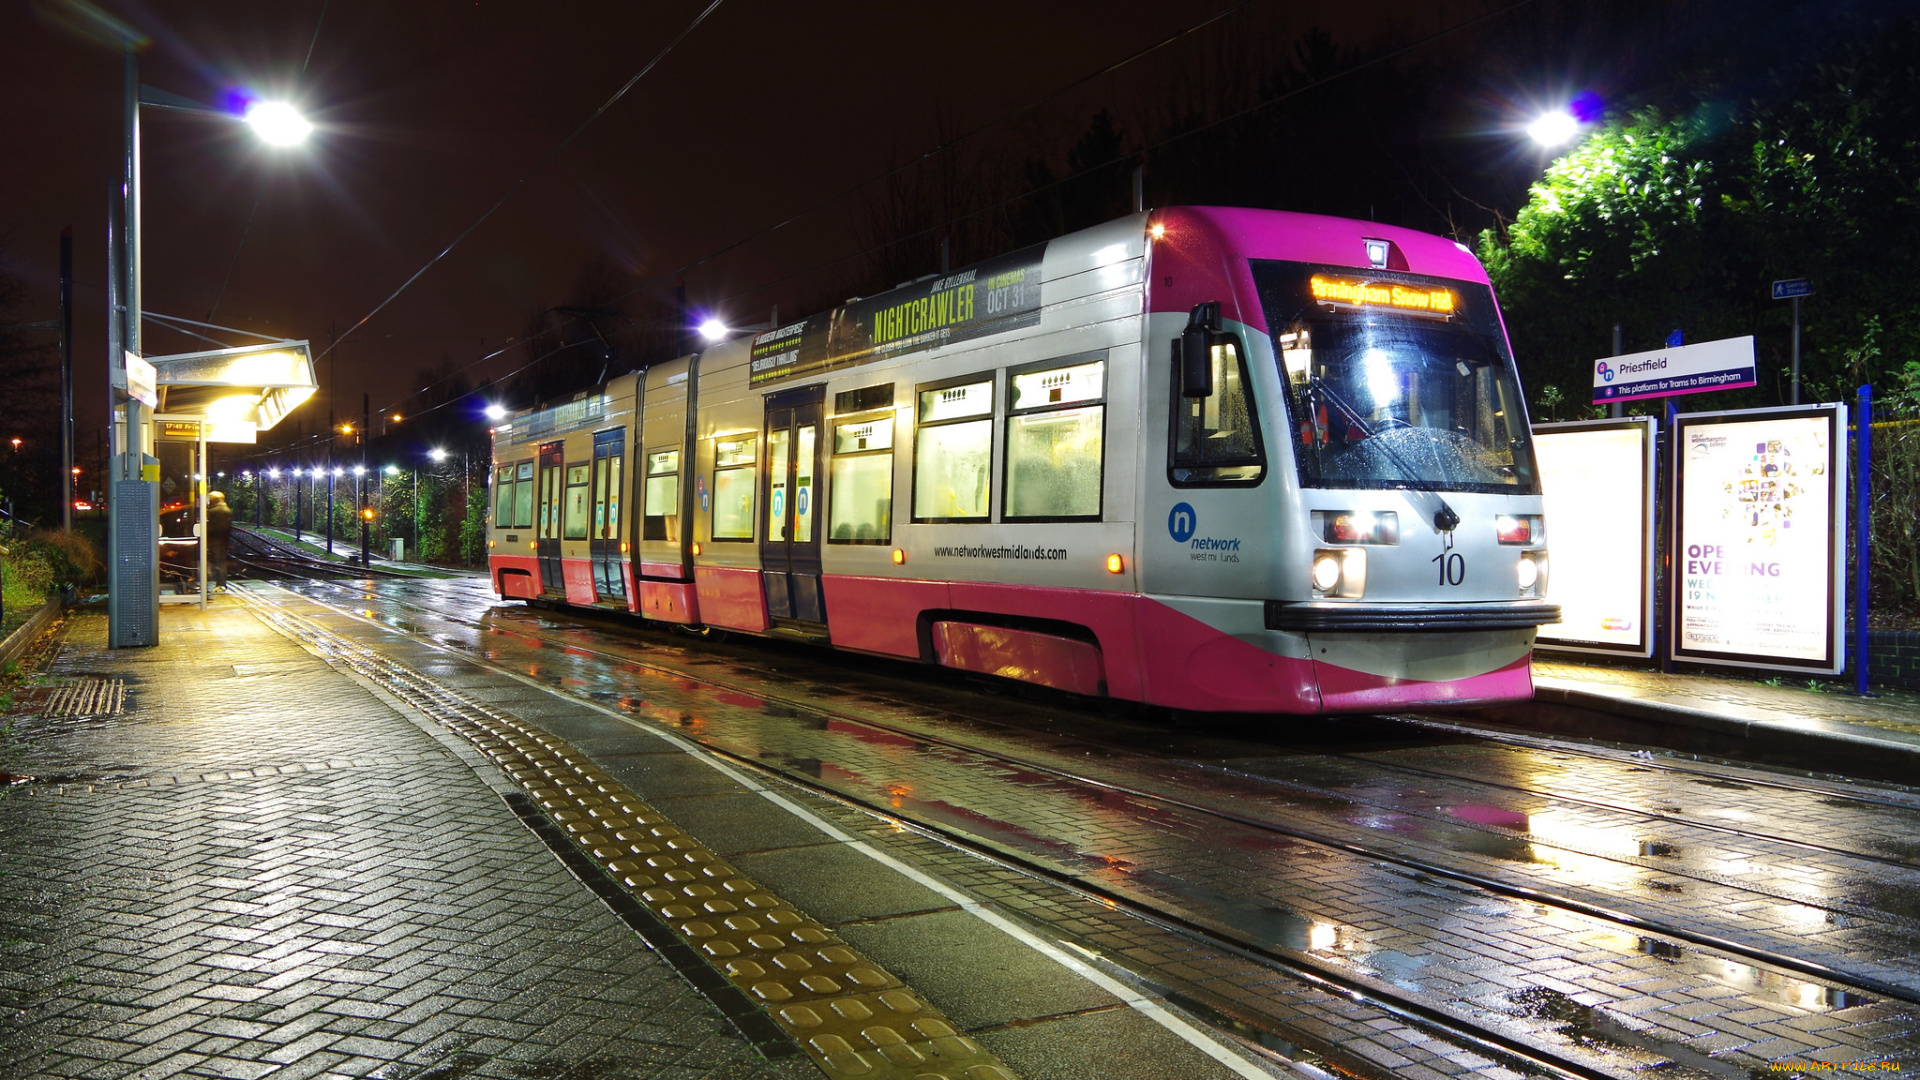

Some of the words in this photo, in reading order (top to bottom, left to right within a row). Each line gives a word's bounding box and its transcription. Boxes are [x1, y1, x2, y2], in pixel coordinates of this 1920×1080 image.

[930, 279, 944, 293] JAKE
[944, 269, 977, 289] GYLLENHAAL
[987, 277, 995, 290] IN
[996, 268, 1025, 288] CINEMAS
[987, 287, 1009, 314] OCT
[1012, 284, 1024, 308] 31
[1311, 277, 1390, 305] Birmingham
[1392, 287, 1429, 307] Snow
[874, 284, 974, 344] NIGHTCRAWLER
[940, 328, 950, 339] GETS
[1619, 357, 1667, 374] Priestfield
[1619, 385, 1631, 395] This
[1632, 383, 1658, 395] platform
[1659, 381, 1668, 389] for
[1669, 379, 1689, 388] Trams
[1698, 373, 1741, 384] Birmingham
[934, 544, 1067, 560] www.networkwestmidlands.com
[1191, 536, 1241, 551] network
[1688, 544, 1725, 558] OPE
[1190, 552, 1207, 561] west
[1431, 553, 1465, 586] 10
